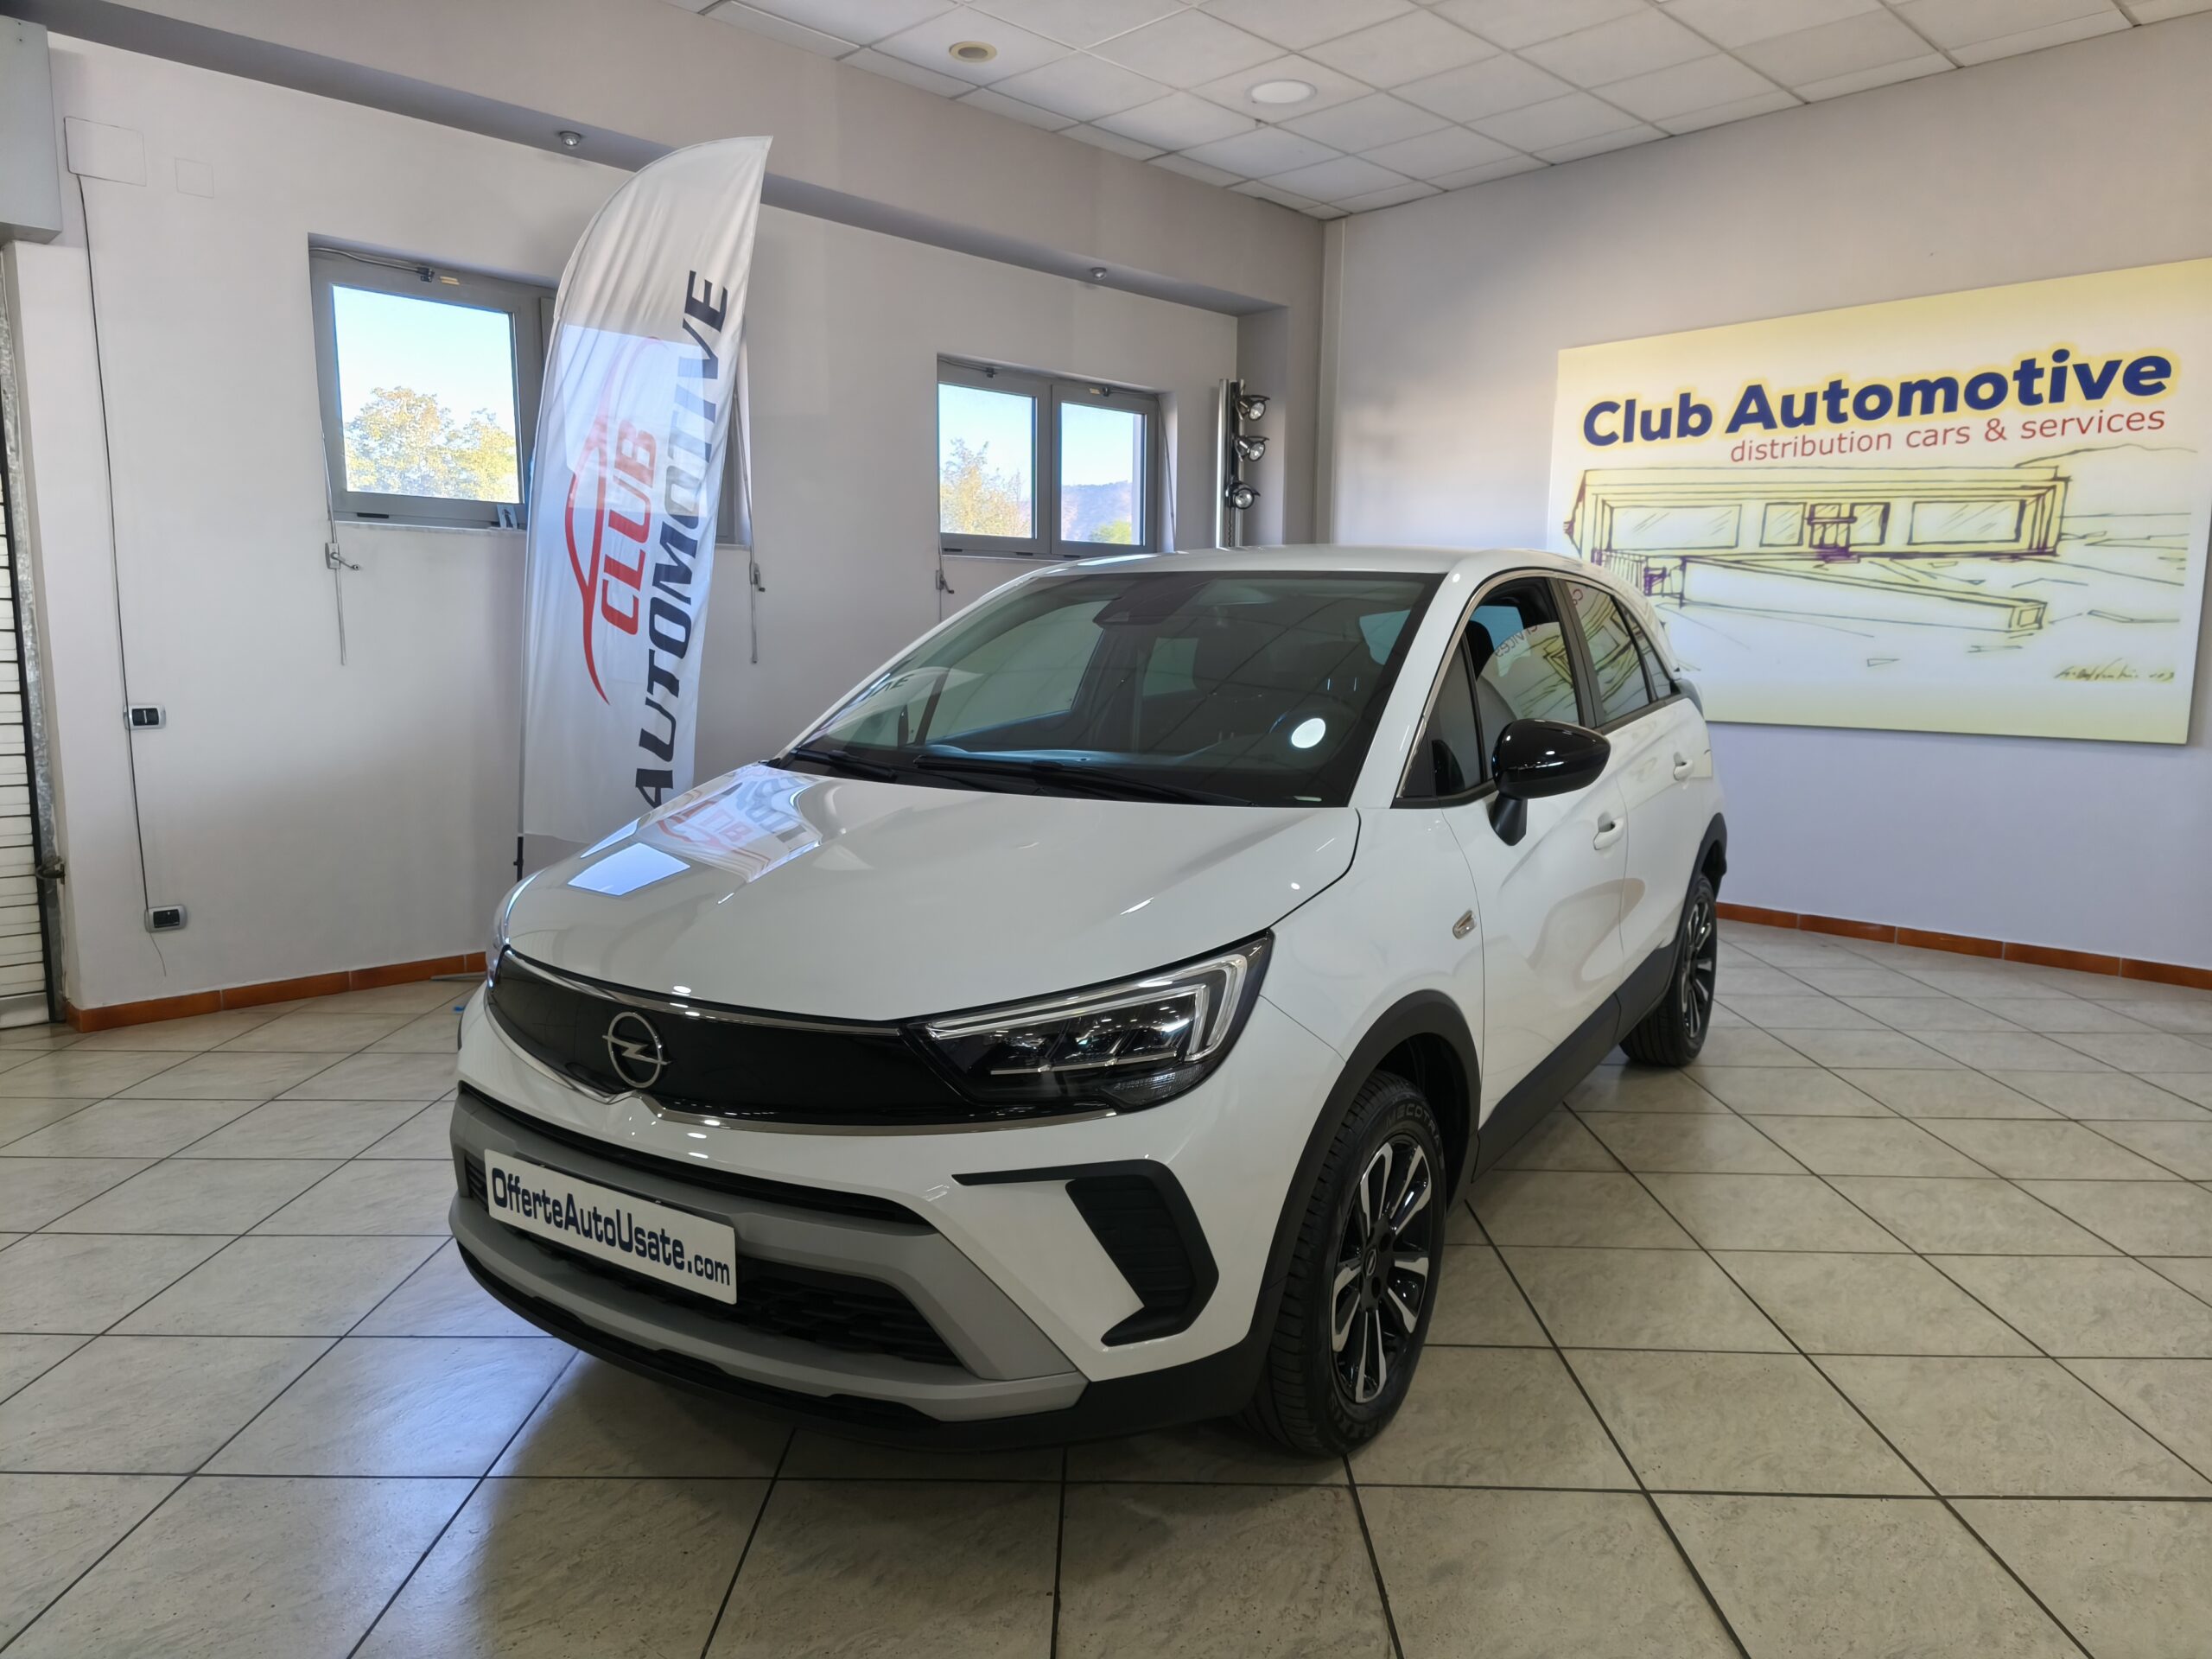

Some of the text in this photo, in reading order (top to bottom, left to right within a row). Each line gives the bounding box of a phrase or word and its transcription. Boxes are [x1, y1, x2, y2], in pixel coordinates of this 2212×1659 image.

[1583, 348, 2172, 447] Club Automotive
[1730, 410, 2166, 462] distribution cars & services
[601, 419, 657, 636] CLUB
[635, 270, 728, 810] AUTOMOTIVE
[492, 1166, 731, 1287] OfferteAutoUsate.com
